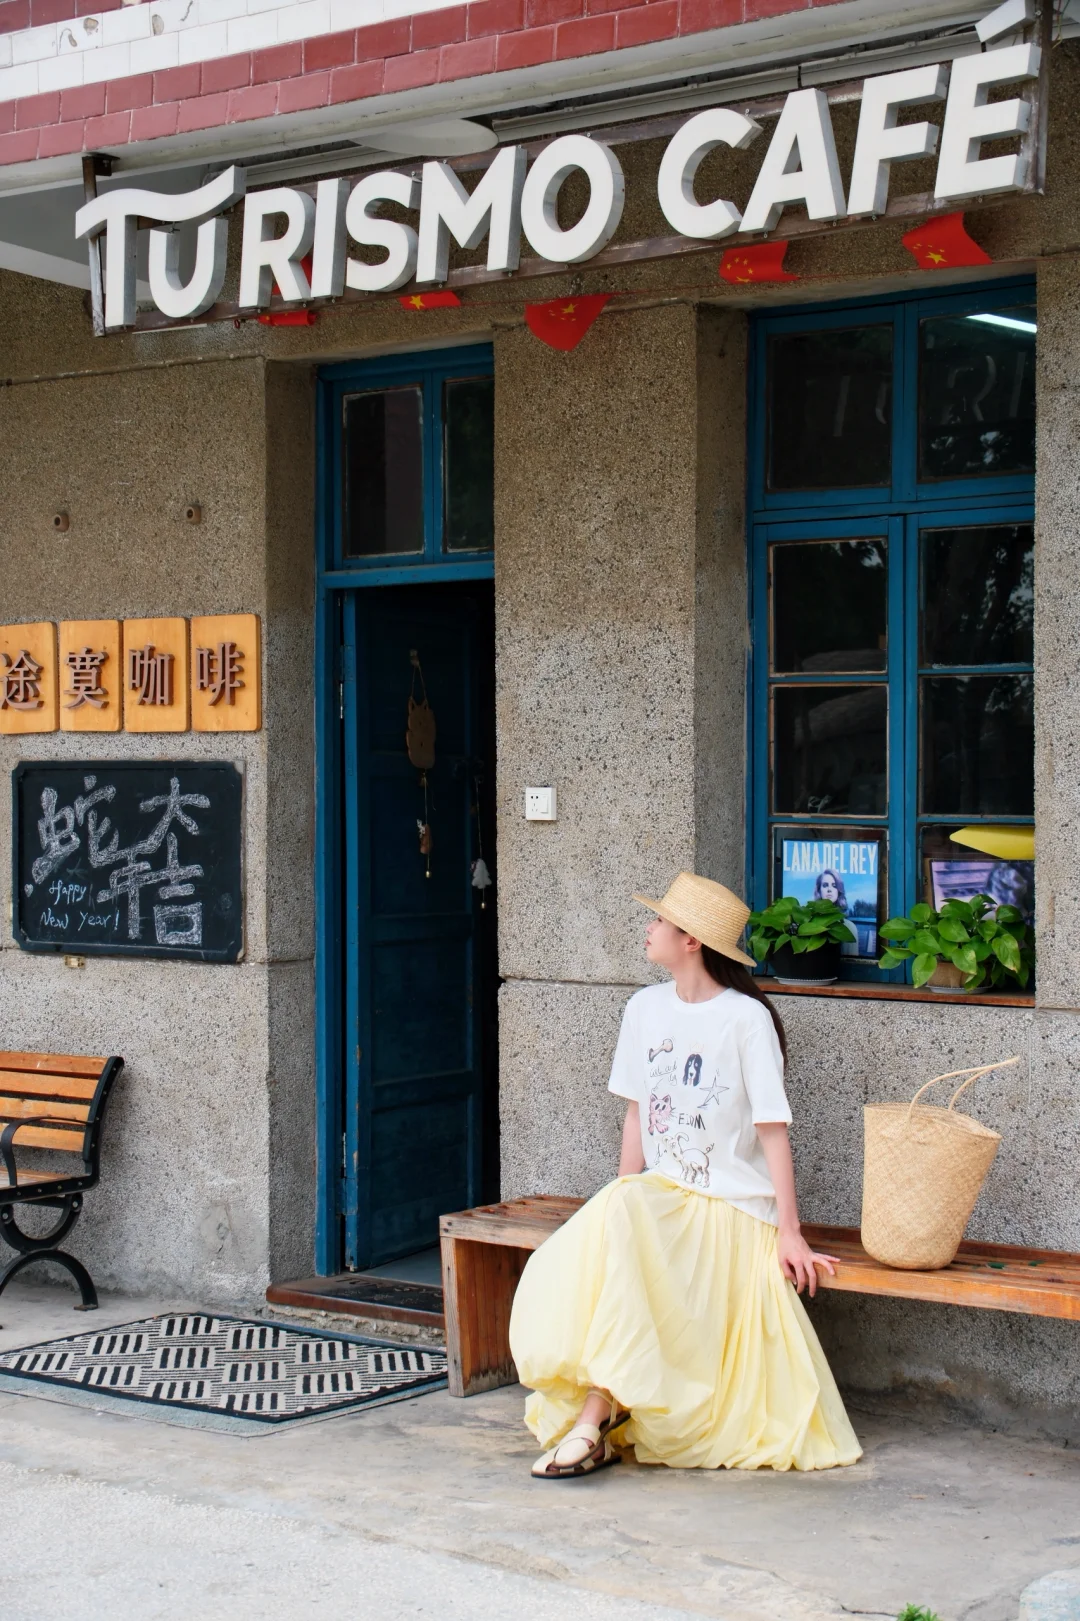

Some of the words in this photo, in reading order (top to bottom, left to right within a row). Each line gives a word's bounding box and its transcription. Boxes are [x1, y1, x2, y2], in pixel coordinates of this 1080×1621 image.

[75, 134, 626, 330] TURISMO
[783, 841, 820, 873] LANA
[823, 843, 848, 873] DEL
[850, 844, 877, 875] REY
[48, 879, 87, 905] Happy
[40, 907, 69, 930] New
